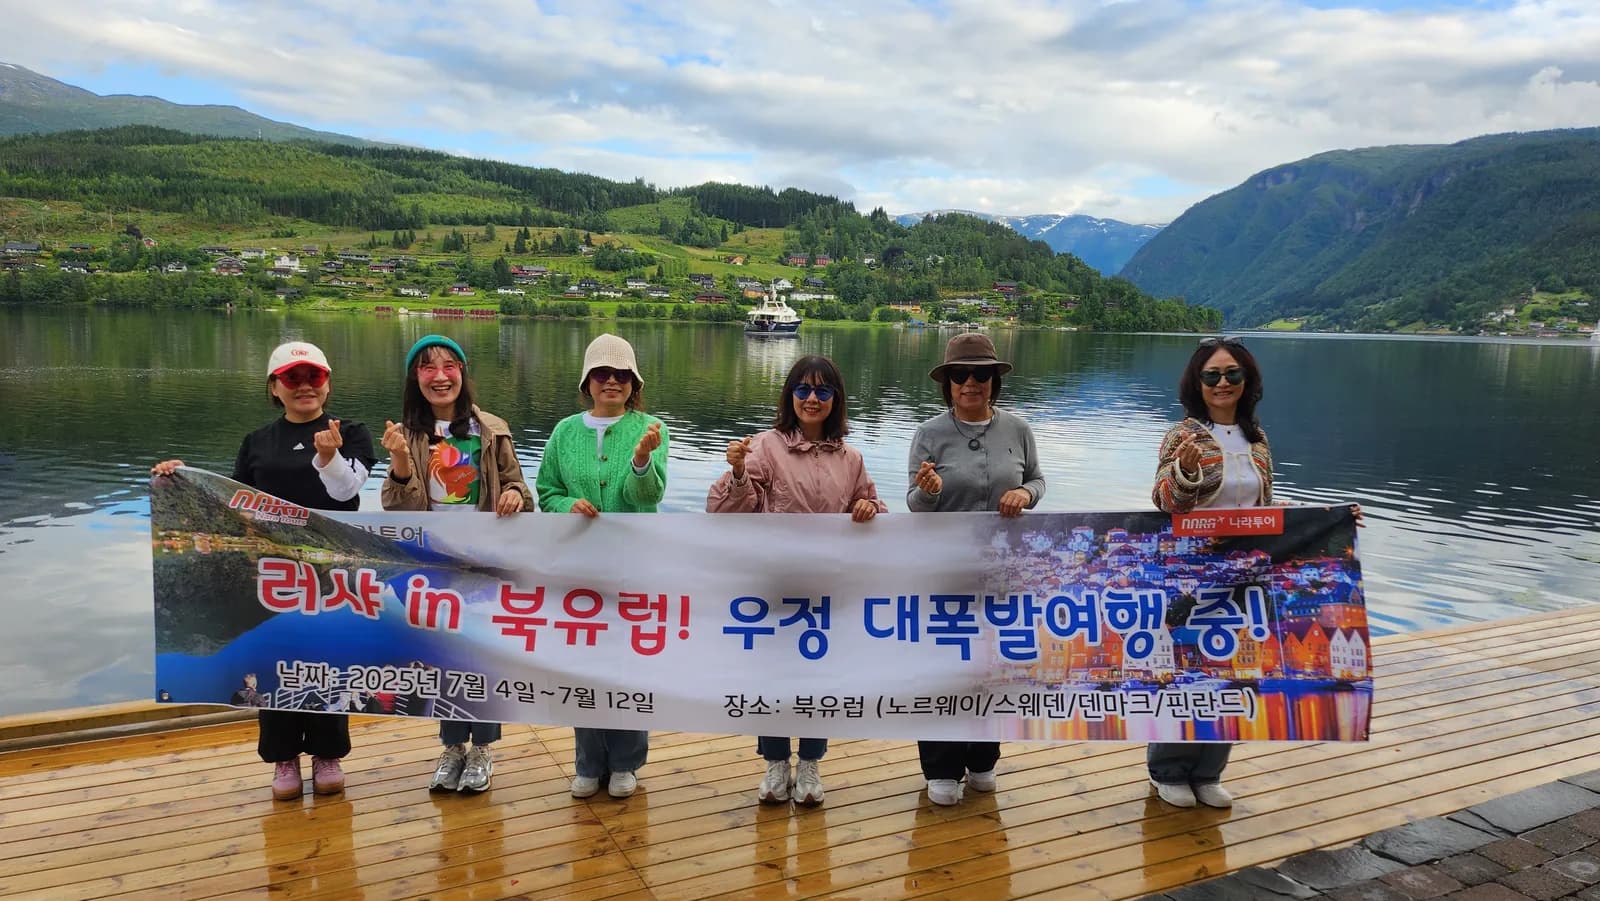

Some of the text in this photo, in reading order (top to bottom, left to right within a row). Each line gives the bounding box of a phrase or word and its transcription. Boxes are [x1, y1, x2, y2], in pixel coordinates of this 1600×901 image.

[1229, 516, 1276, 528] 나라투어
[260, 560, 1266, 661] 러샤 in 북유럽! 우정 대폭발여행 중!
[278, 662, 339, 690] 날짜:
[350, 667, 441, 696] 2025년
[448, 673, 486, 699] 7월
[606, 691, 655, 714] 12일
[723, 690, 1257, 720] 장소: 북유럽 (노르웨이/스웨덴/덴마크/핀란드)
